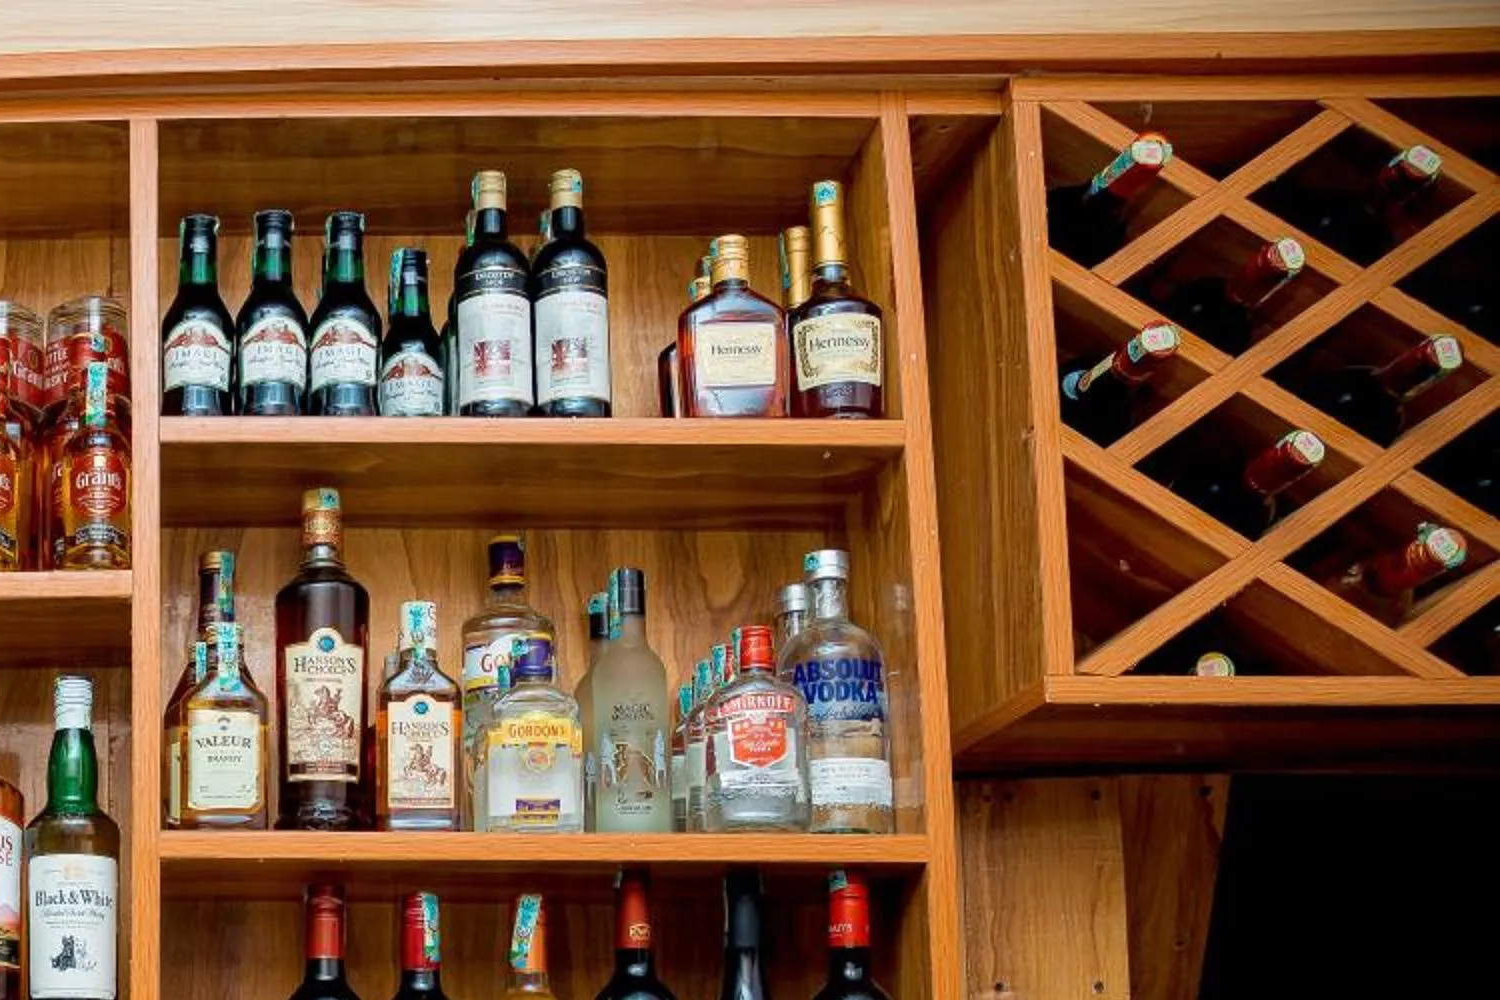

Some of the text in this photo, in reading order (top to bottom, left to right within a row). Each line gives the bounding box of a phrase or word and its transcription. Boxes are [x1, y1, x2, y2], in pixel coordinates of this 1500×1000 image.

[710, 344, 763, 356] Hennessy
[808, 334, 871, 351] Hennessy
[793, 657, 882, 686] ABSOLUT
[802, 680, 879, 705] VODKA
[194, 734, 252, 750] VALEUR
